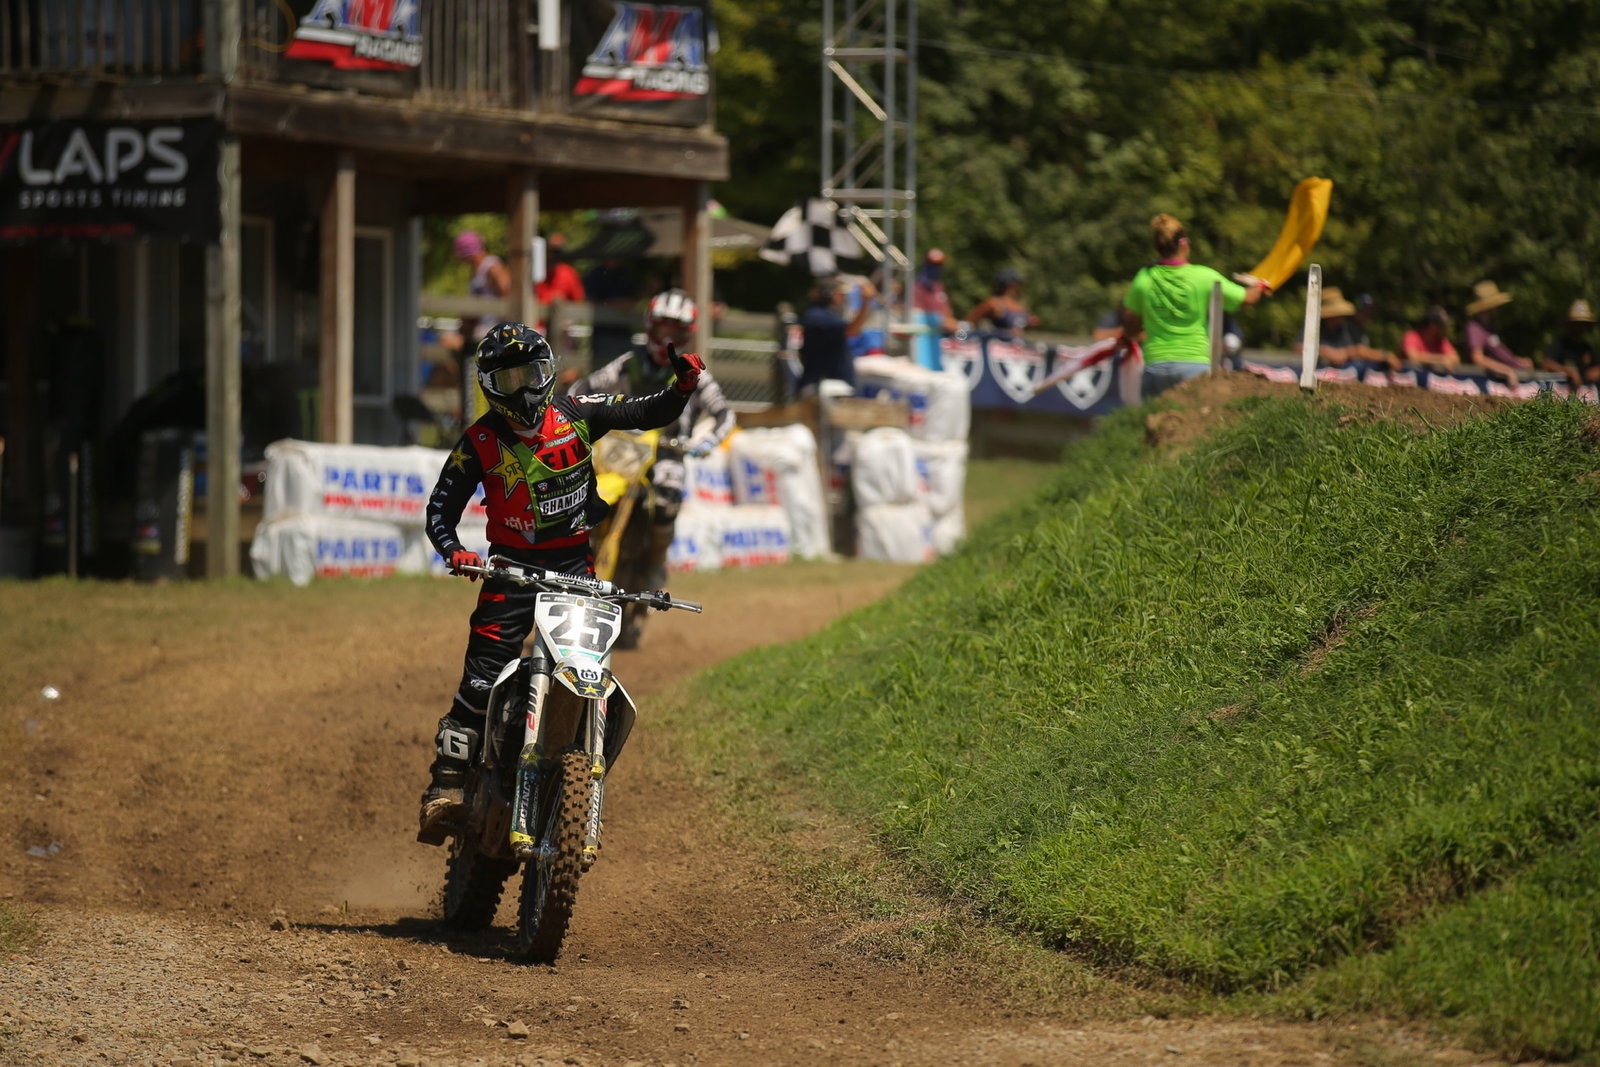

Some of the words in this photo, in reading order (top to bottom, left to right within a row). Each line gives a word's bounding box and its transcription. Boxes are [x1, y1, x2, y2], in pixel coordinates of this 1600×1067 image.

[0, 127, 188, 186] LAPS
[19, 189, 102, 210] SPORTS
[111, 187, 186, 208] TIMING
[325, 468, 424, 493] PARTS
[317, 539, 399, 560] PARTS
[548, 604, 617, 653] 25
[590, 781, 601, 841] DUNLOP
